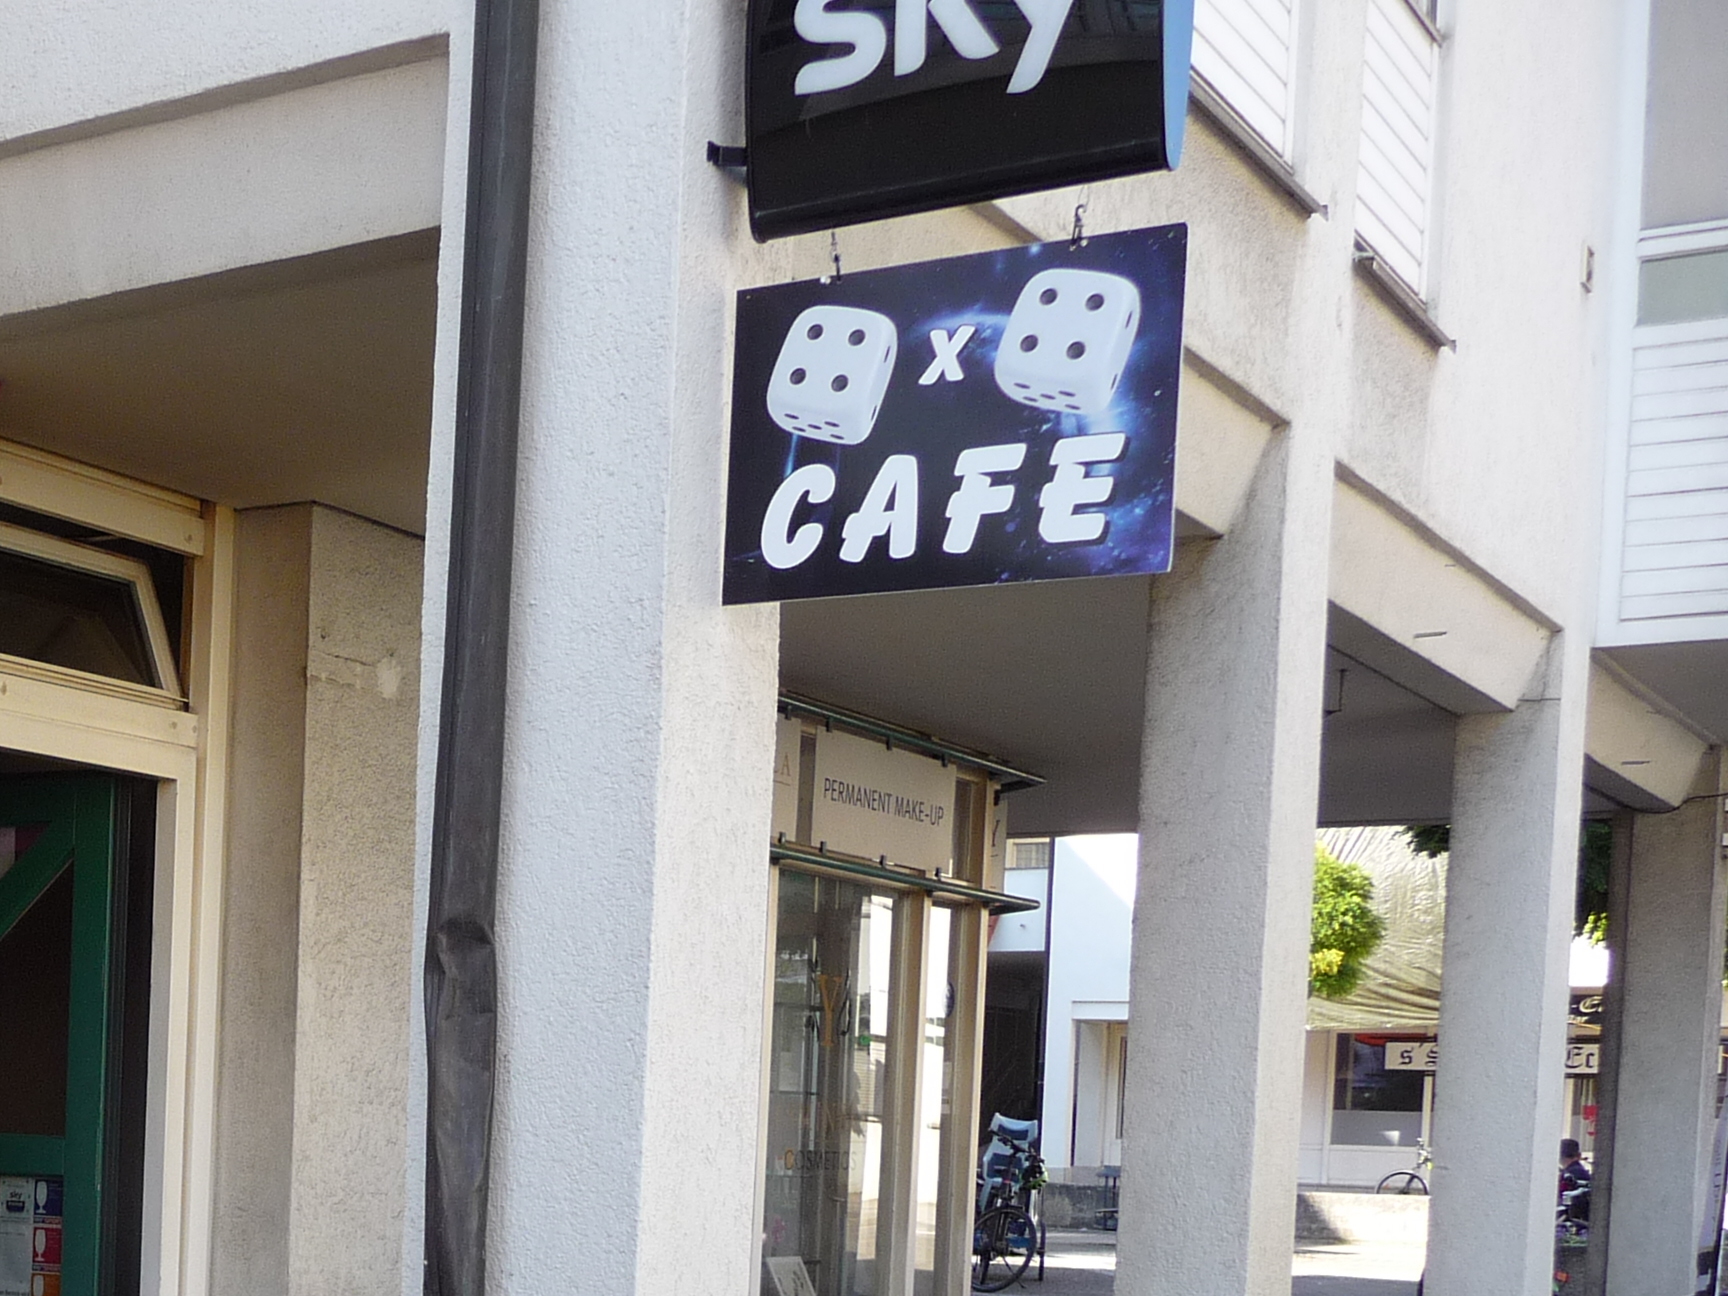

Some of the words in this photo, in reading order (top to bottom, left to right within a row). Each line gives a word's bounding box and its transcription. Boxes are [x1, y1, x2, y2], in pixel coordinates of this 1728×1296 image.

[761, 432, 1126, 569] CAFE
[823, 777, 893, 815] PERMANENT
[894, 796, 945, 827] MAKE-UP
